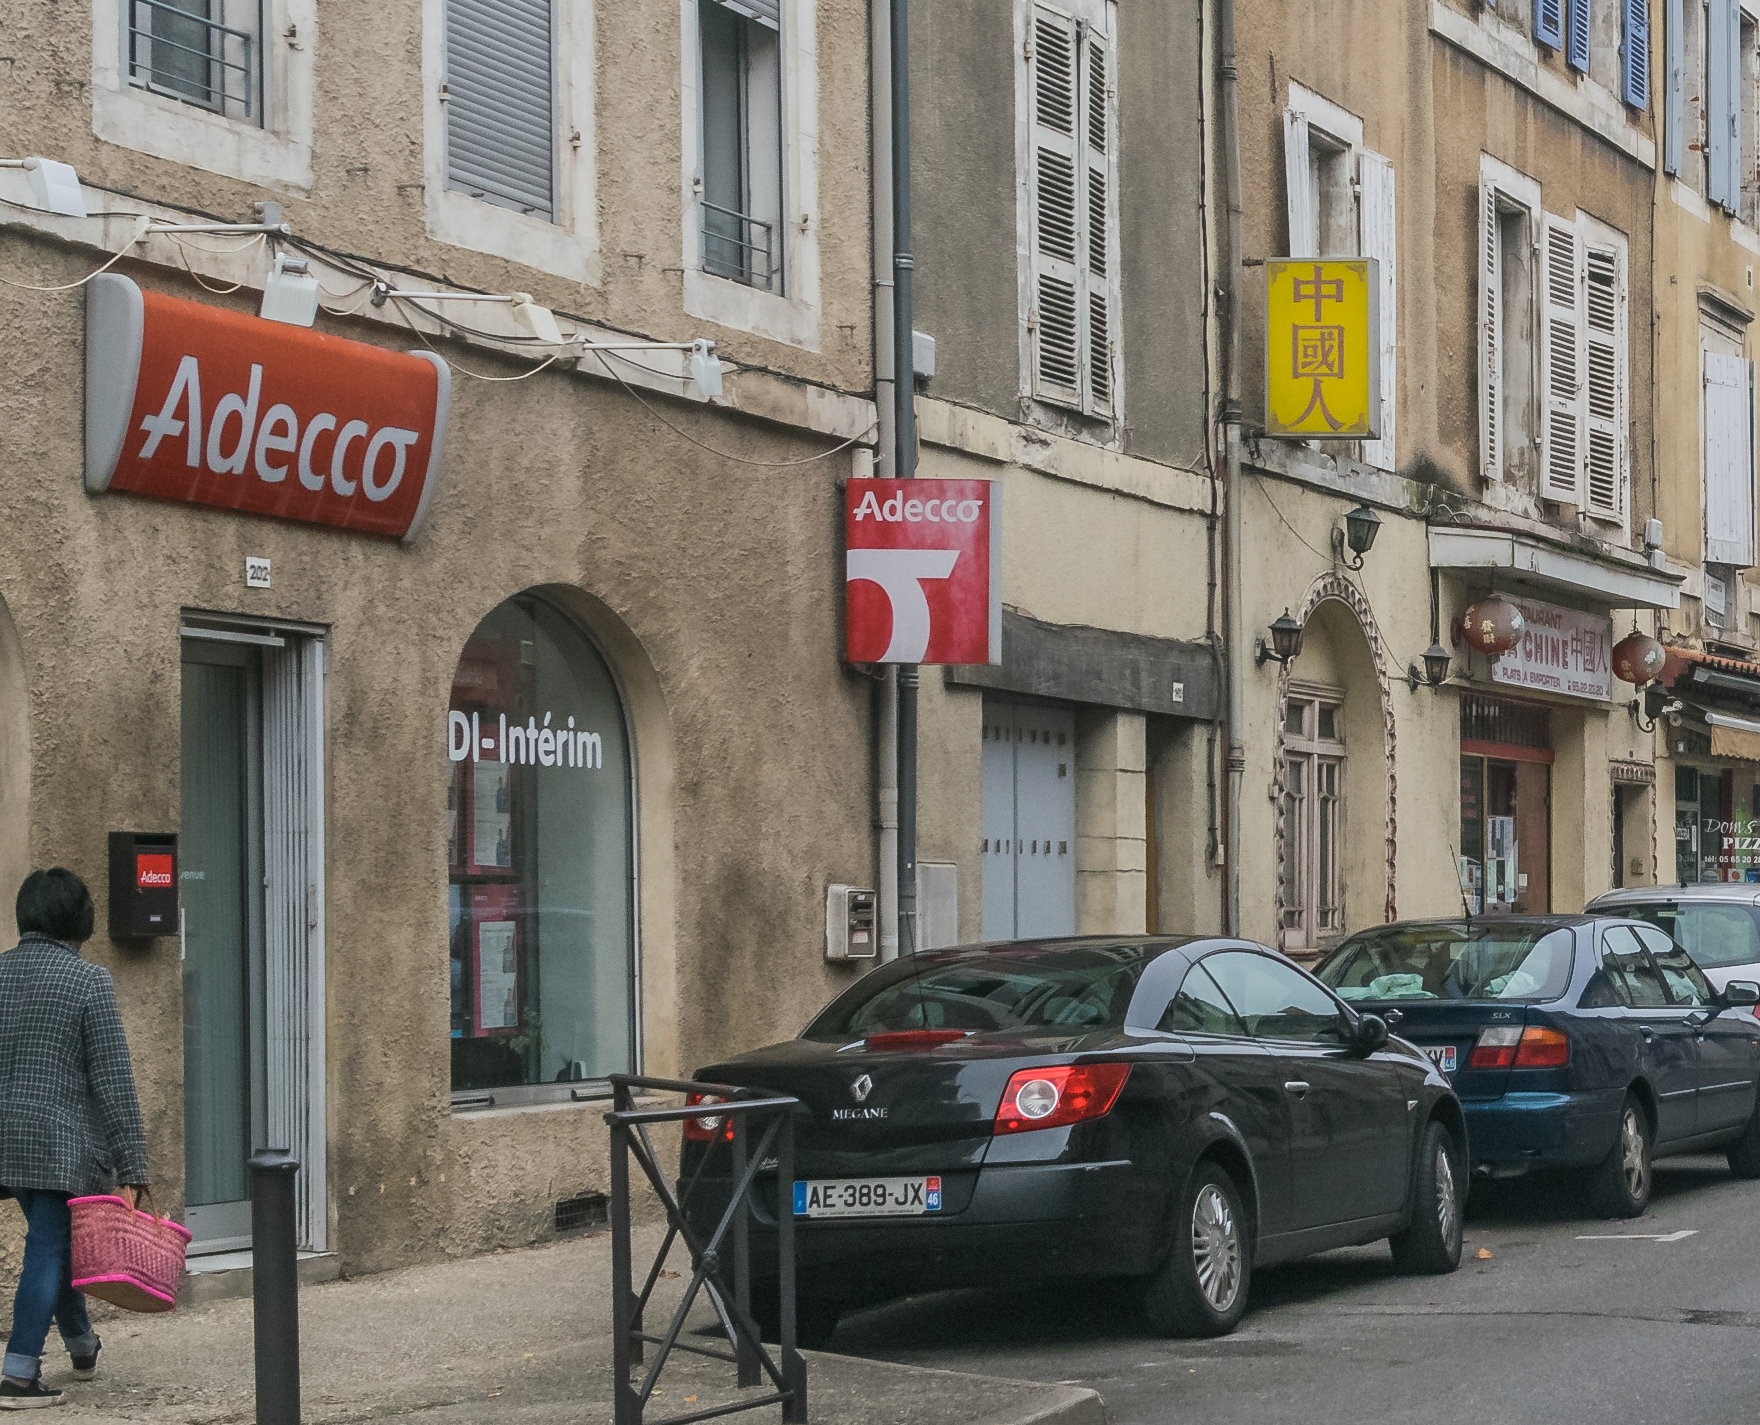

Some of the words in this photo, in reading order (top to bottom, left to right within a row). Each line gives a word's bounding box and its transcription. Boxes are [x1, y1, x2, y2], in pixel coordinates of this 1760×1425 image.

[1287, 264, 1346, 431] 中國人
[138, 354, 419, 502] Adecco
[852, 490, 983, 523] Adecco
[250, 565, 269, 581] 202
[1523, 630, 1569, 670] CHINE
[1571, 627, 1608, 674] 中國人
[1502, 666, 1521, 681] PLATS
[1530, 671, 1560, 688] EMPORTER
[1704, 854, 1718, 863] tél:
[141, 870, 171, 884] Adecco
[833, 1108, 888, 1119] MEGANE
[808, 1182, 924, 1209] AE-389-JX
[927, 1192, 938, 1206] 46
